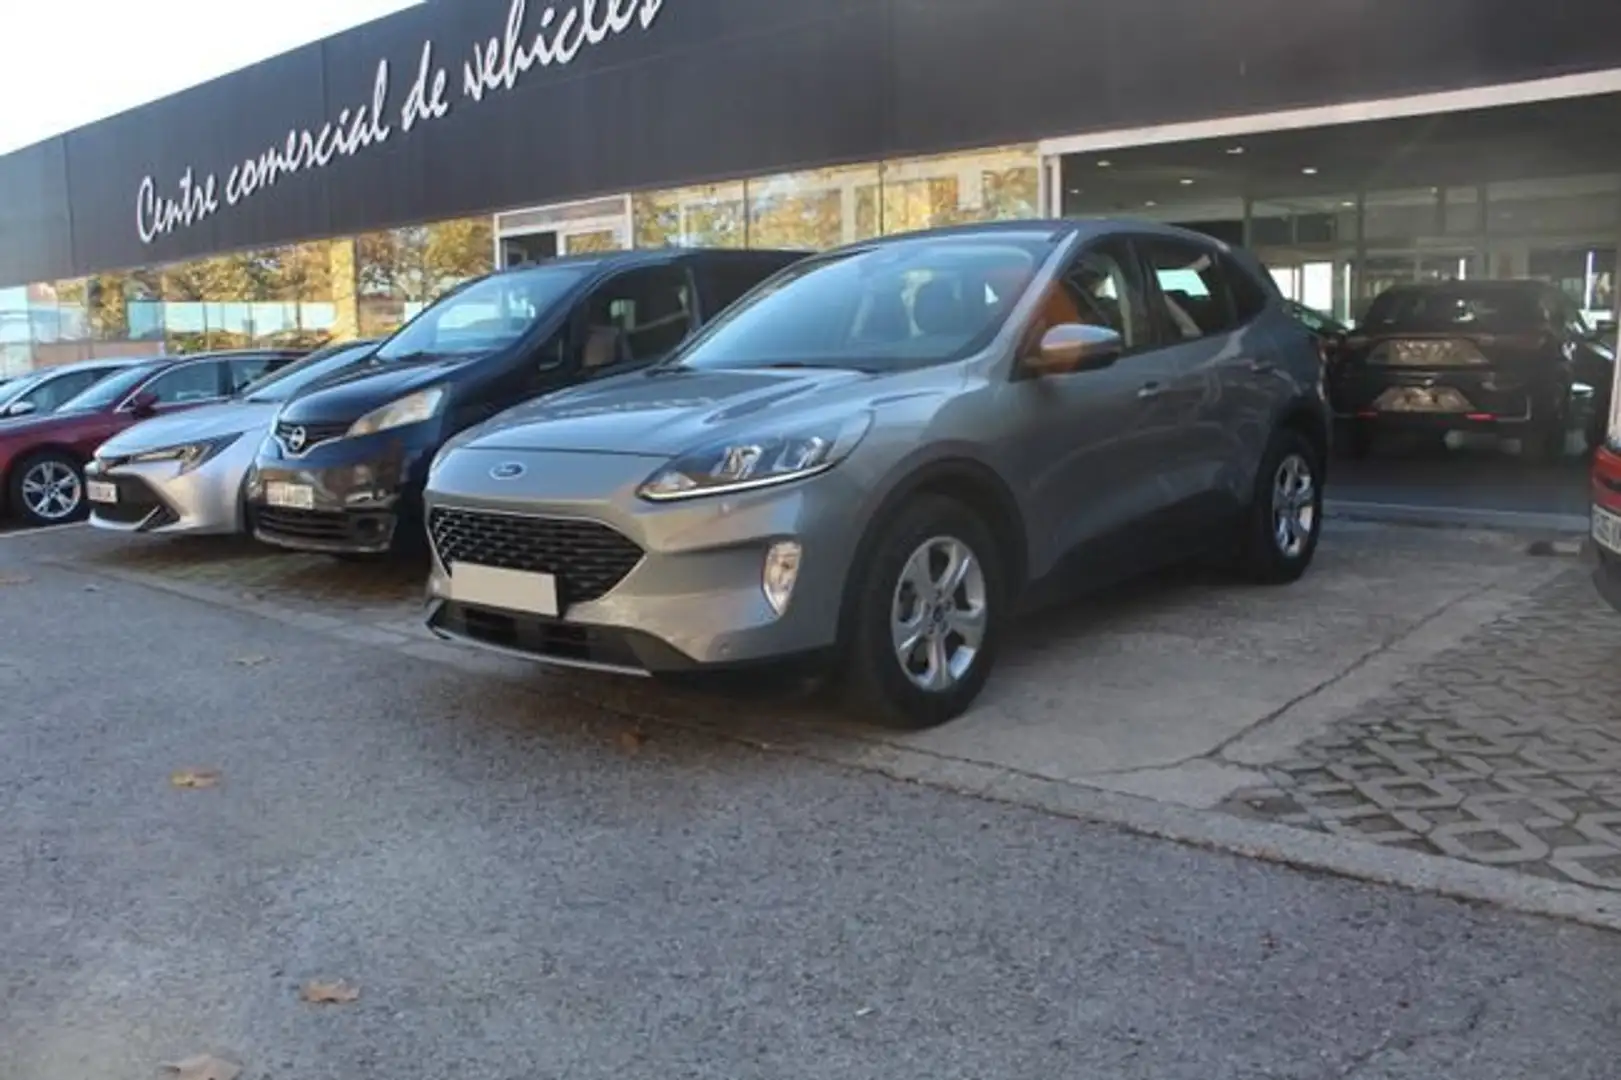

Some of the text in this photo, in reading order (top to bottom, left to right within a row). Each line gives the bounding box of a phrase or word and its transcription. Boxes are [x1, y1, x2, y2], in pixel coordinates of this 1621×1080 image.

[137, 166, 218, 243] Centre
[226, 59, 389, 205] comercial
[402, 40, 448, 131] de
